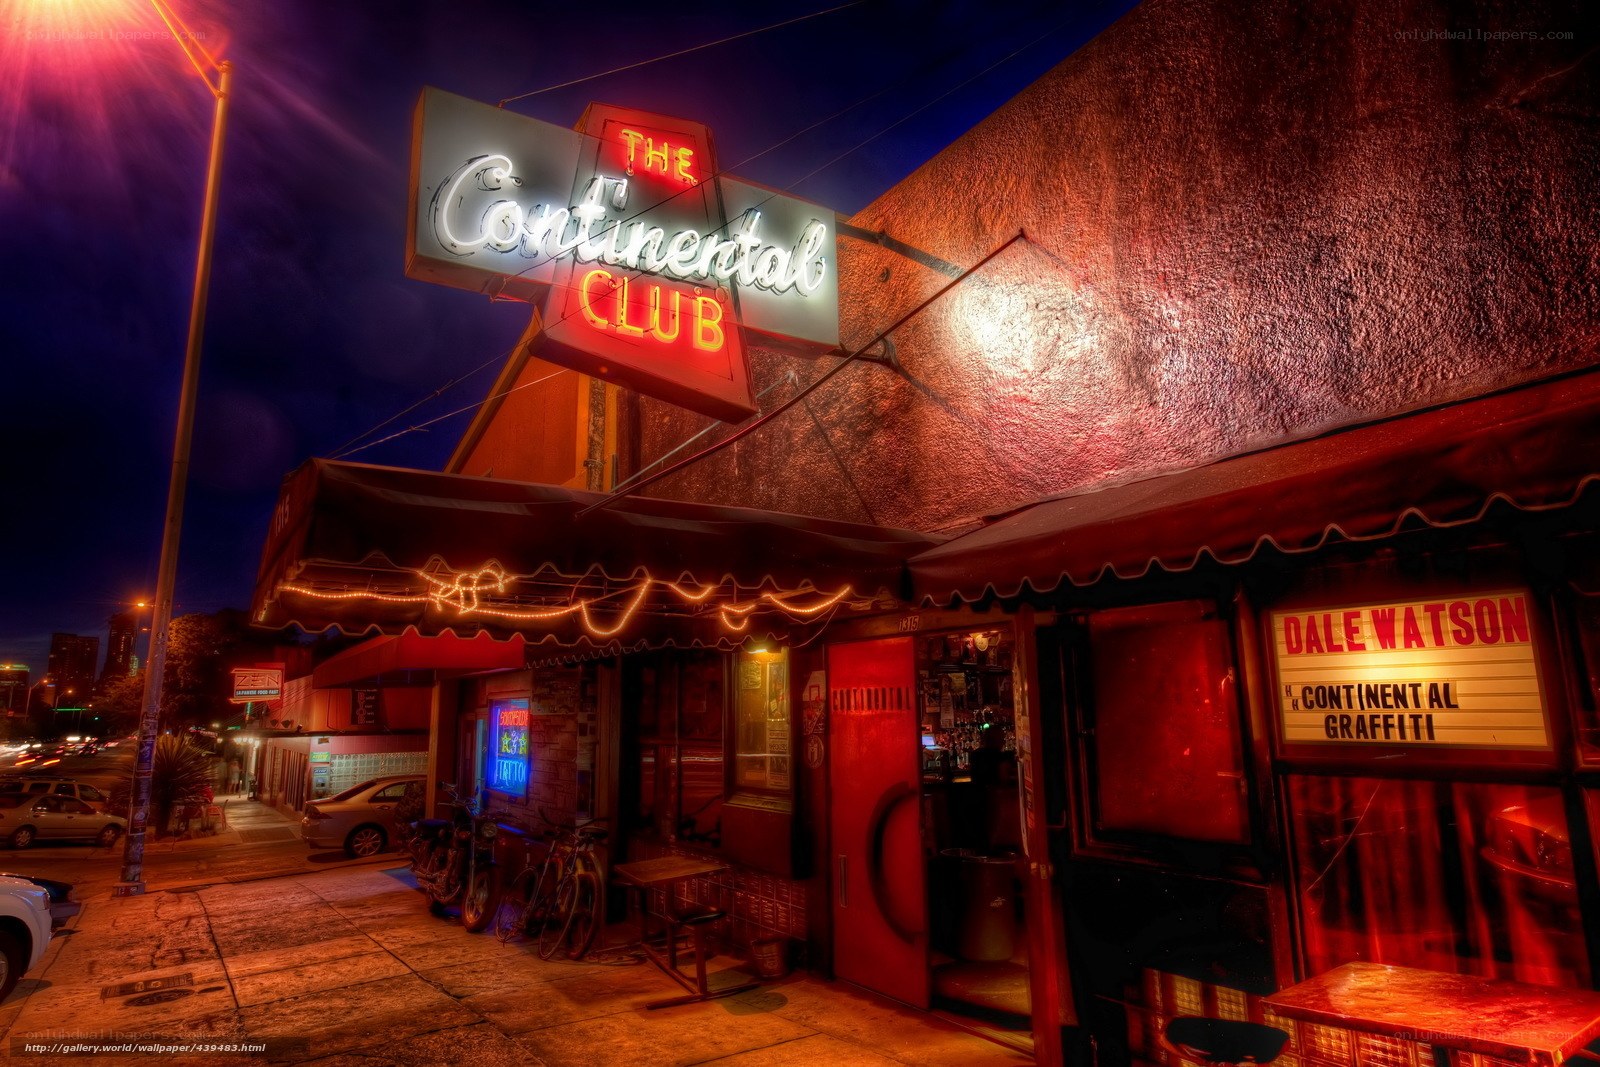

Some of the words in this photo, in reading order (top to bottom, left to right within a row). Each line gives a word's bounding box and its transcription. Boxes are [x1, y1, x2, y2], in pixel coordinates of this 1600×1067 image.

[620, 129, 698, 184] THE
[432, 153, 826, 296] Continental
[580, 270, 726, 351] CLUB
[1284, 611, 1366, 654] DALE
[1371, 597, 1529, 649] WATSON
[237, 675, 280, 687] ZEN
[1302, 682, 1458, 710] CONTINENTAL
[1324, 714, 1435, 741] GRAFFITI
